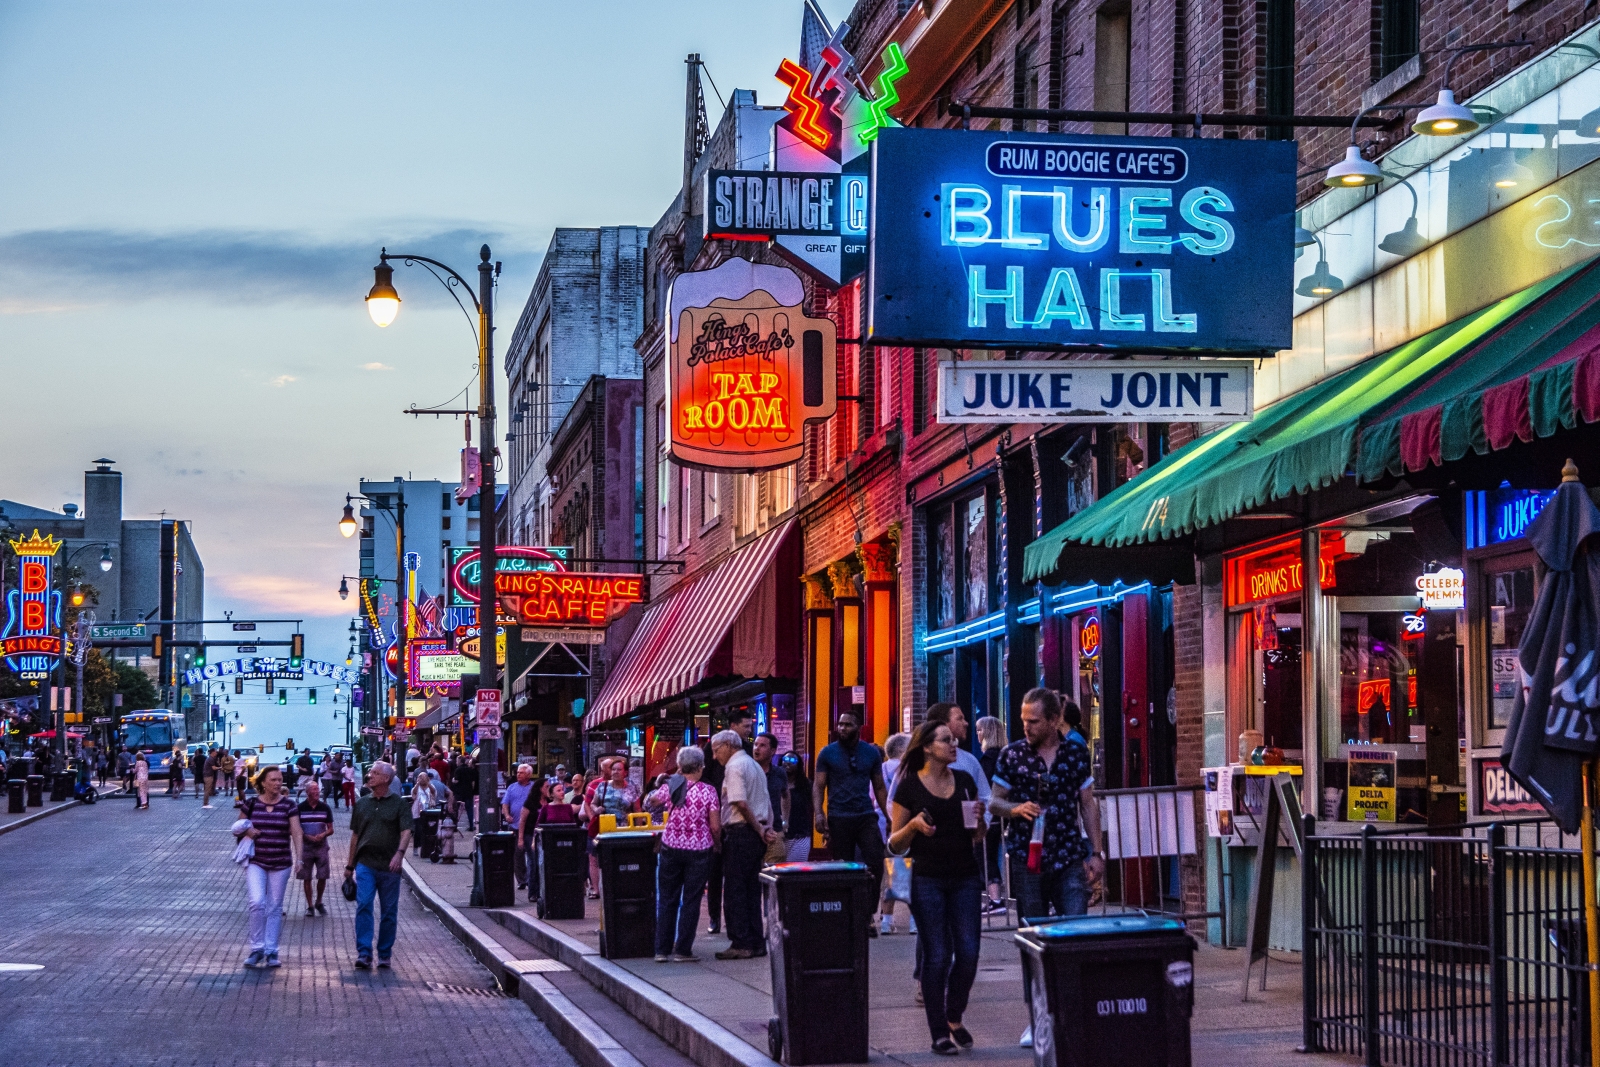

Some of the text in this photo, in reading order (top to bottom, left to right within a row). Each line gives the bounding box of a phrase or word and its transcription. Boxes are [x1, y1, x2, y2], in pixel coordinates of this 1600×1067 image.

[1000, 147, 1175, 175] RUM BOOGIE CAFE'S
[715, 175, 833, 230] STRANGE
[940, 183, 1235, 255] BLUES
[805, 244, 837, 253] GREAT
[968, 265, 1198, 333] HALL
[697, 319, 750, 346] Kings
[687, 328, 795, 367] Palace Cafe's
[713, 372, 779, 400] TAP
[963, 371, 1229, 409] JUKE JOINT
[685, 397, 786, 429] ROOM
[1141, 495, 1170, 531] 174
[1499, 494, 1539, 540] JUKE
[496, 572, 554, 592] KING'S
[1251, 567, 1288, 599] DRINKS
[524, 600, 606, 619] CAFE
[102, 625, 131, 637] Second
[523, 631, 603, 641] AIR CONDITIOND
[6, 638, 60, 652] KING'S
[21, 656, 48, 670] BLUES
[186, 657, 254, 685] HOME
[247, 671, 299, 679] BEALE STREET
[1493, 658, 1514, 674] $5
[481, 691, 496, 700] NO
[1354, 800, 1389, 810] PROJECT
[1359, 789, 1384, 799] DELTA
